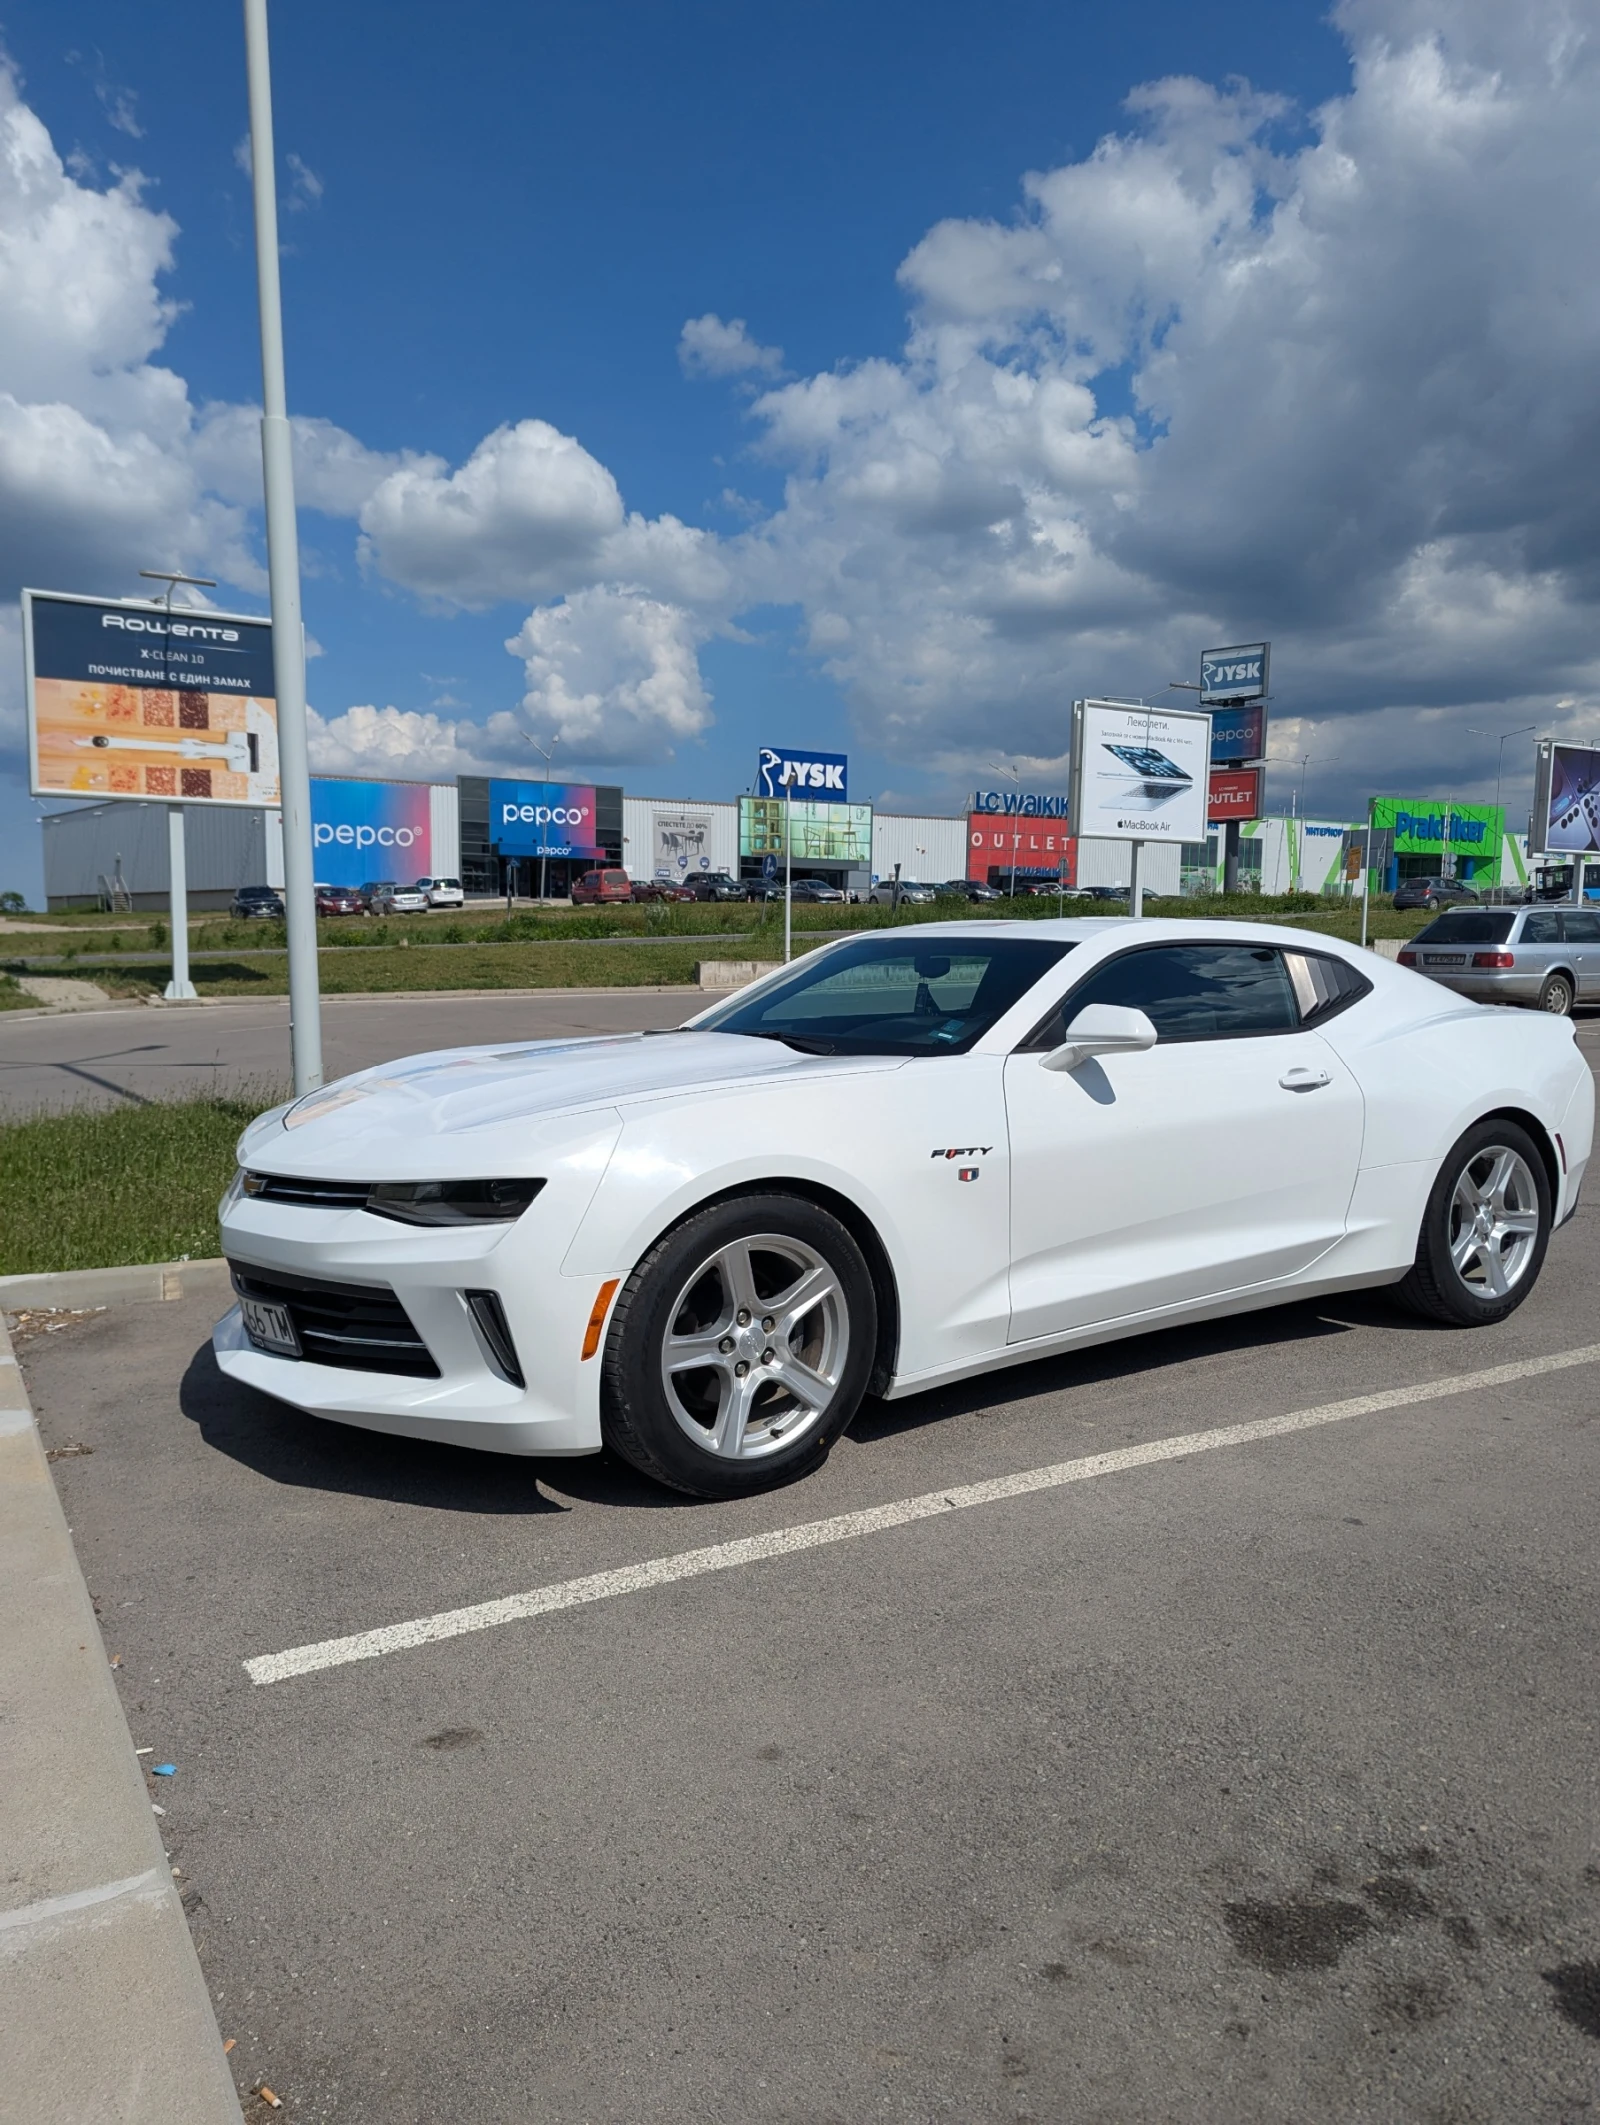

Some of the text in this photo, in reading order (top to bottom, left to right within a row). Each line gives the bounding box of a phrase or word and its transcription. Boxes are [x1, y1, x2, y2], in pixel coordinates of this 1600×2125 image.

[191, 654, 204, 664] 10
[88, 664, 251, 688] ПОЧИСТВАНЕ С ЕДИН ЗАМАХ
[1214, 661, 1261, 683] JYSK
[778, 761, 844, 789] JYSK
[976, 792, 999, 811] LC
[1123, 819, 1171, 831] MacBook Air
[971, 832, 1070, 850] OUTLET
